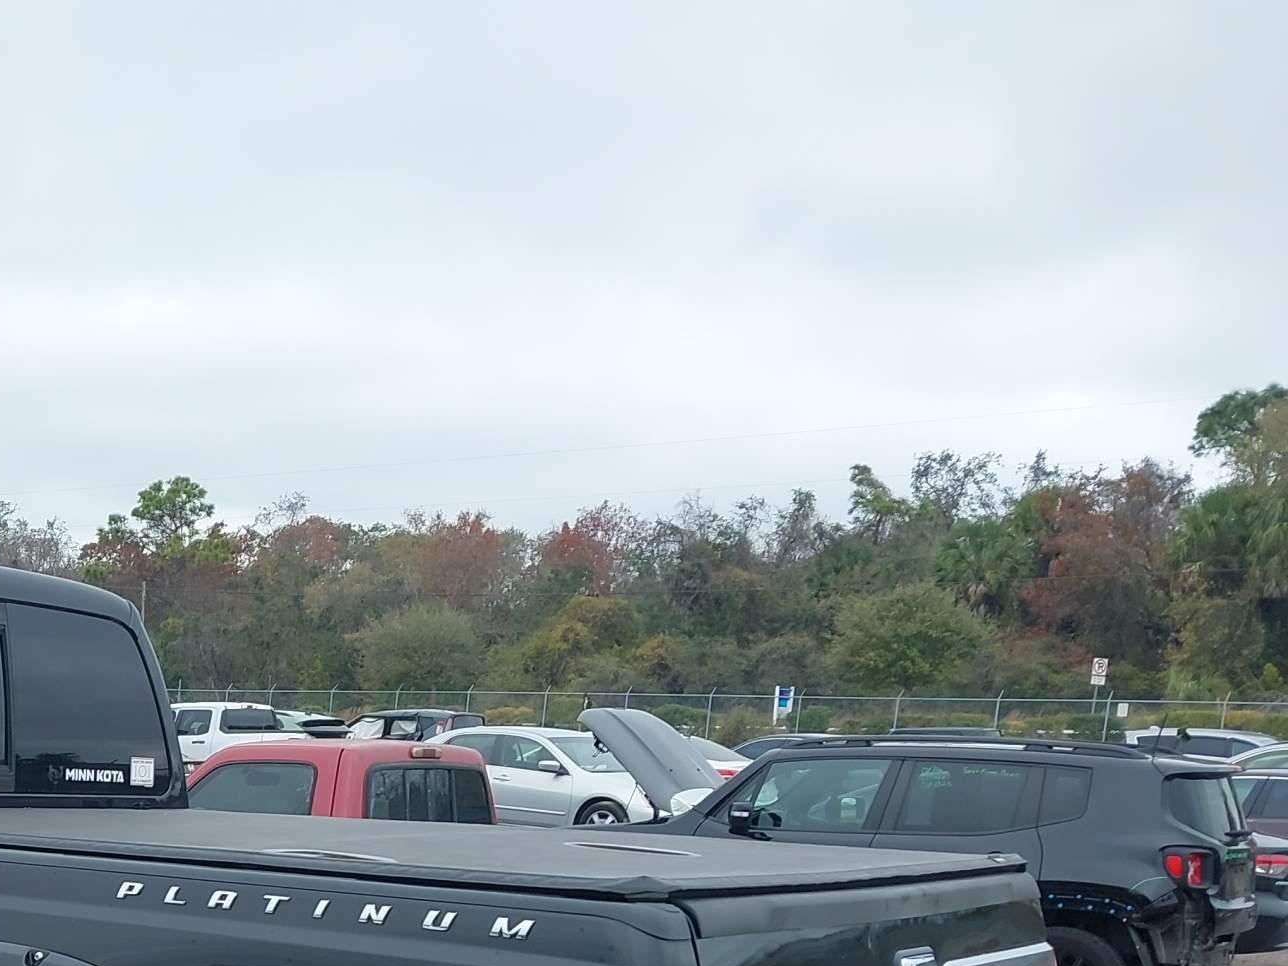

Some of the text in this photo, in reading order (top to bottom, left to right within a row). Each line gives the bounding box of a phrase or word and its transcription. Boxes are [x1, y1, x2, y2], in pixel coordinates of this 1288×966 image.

[65, 768, 124, 783] MINN KOTA
[116, 881, 535, 940] PLATINUM
